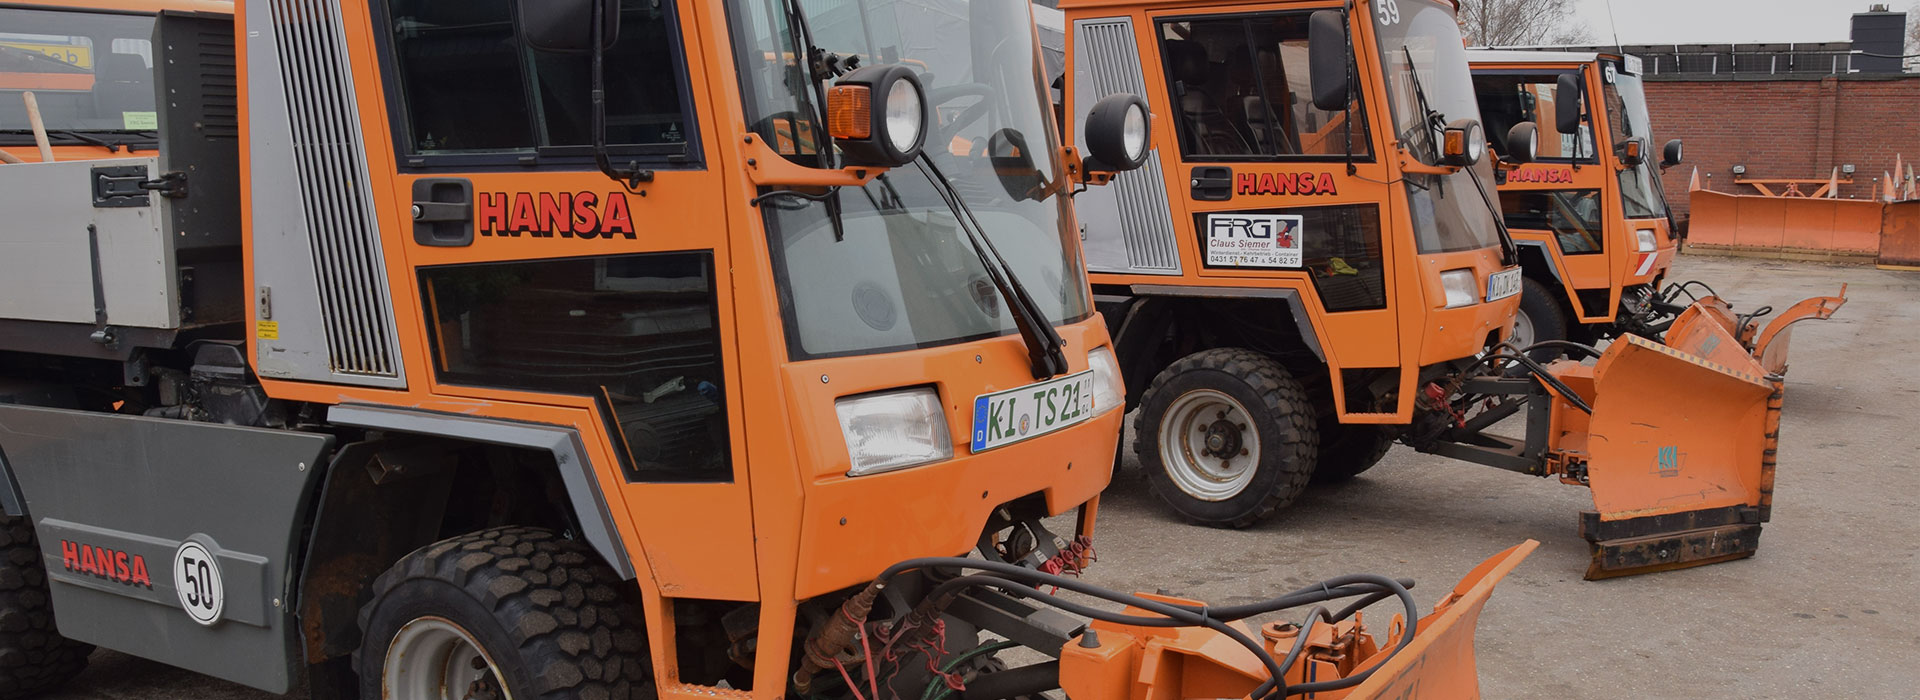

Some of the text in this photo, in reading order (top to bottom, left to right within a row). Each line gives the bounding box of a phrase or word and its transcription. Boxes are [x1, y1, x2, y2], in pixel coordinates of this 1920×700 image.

[1377, 0, 1400, 26] 59
[1237, 172, 1337, 196] HANSA
[1507, 167, 1573, 183] HANSA
[479, 190, 637, 239] HANSA
[1210, 217, 1271, 238] FRG
[1210, 238, 1271, 249] Claus Siemer
[1210, 255, 1227, 263] 0431
[1229, 255, 1238, 263] 57
[1239, 255, 1249, 263] 76
[1268, 256, 1277, 264] 54
[1278, 257, 1288, 265] 82
[1289, 257, 1299, 265] 57
[988, 380, 1081, 442] KI TS 21
[976, 429, 984, 442] D
[61, 539, 153, 591] HANSA
[183, 556, 214, 611] 50
